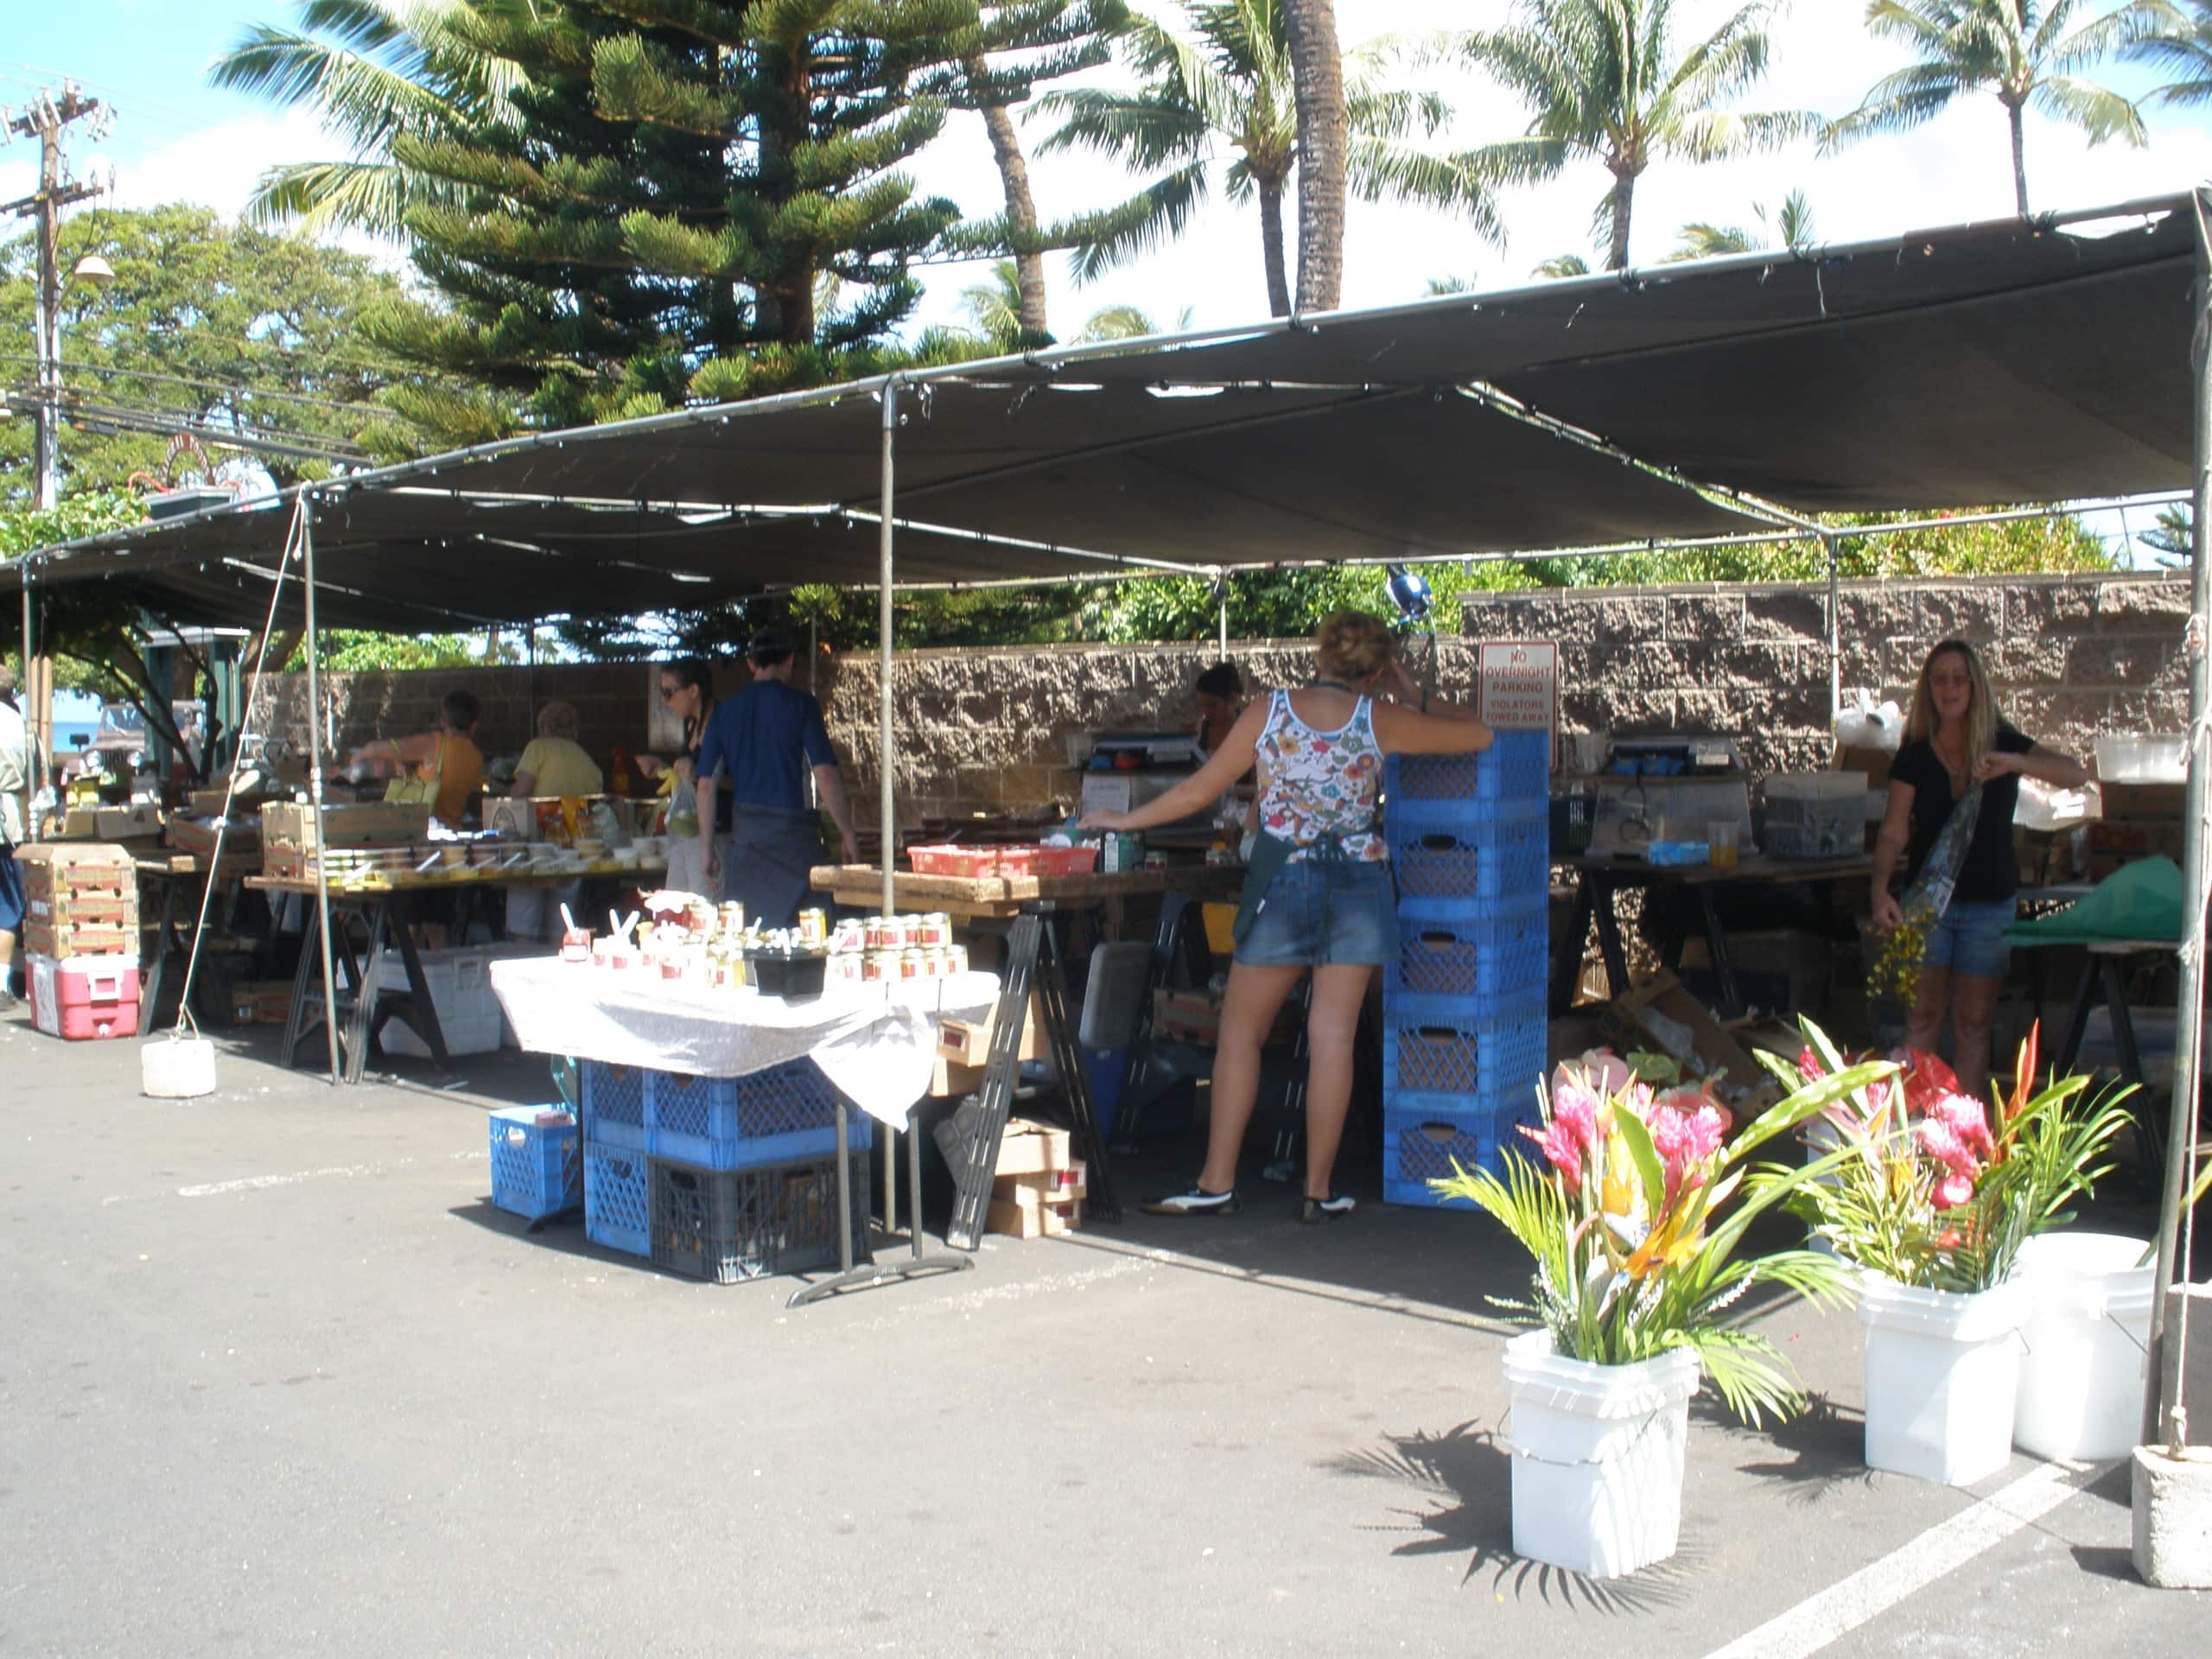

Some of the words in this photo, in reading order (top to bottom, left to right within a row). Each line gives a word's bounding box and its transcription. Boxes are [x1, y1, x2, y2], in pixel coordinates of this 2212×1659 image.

[1511, 651, 1528, 664] NO
[1486, 666, 1550, 678] OVERNIGHT
[1492, 682, 1543, 693] PARKING
[1491, 700, 1544, 710] VIOLATORS
[1486, 712, 1519, 721] TOWED
[1522, 712, 1549, 721] AWAY
